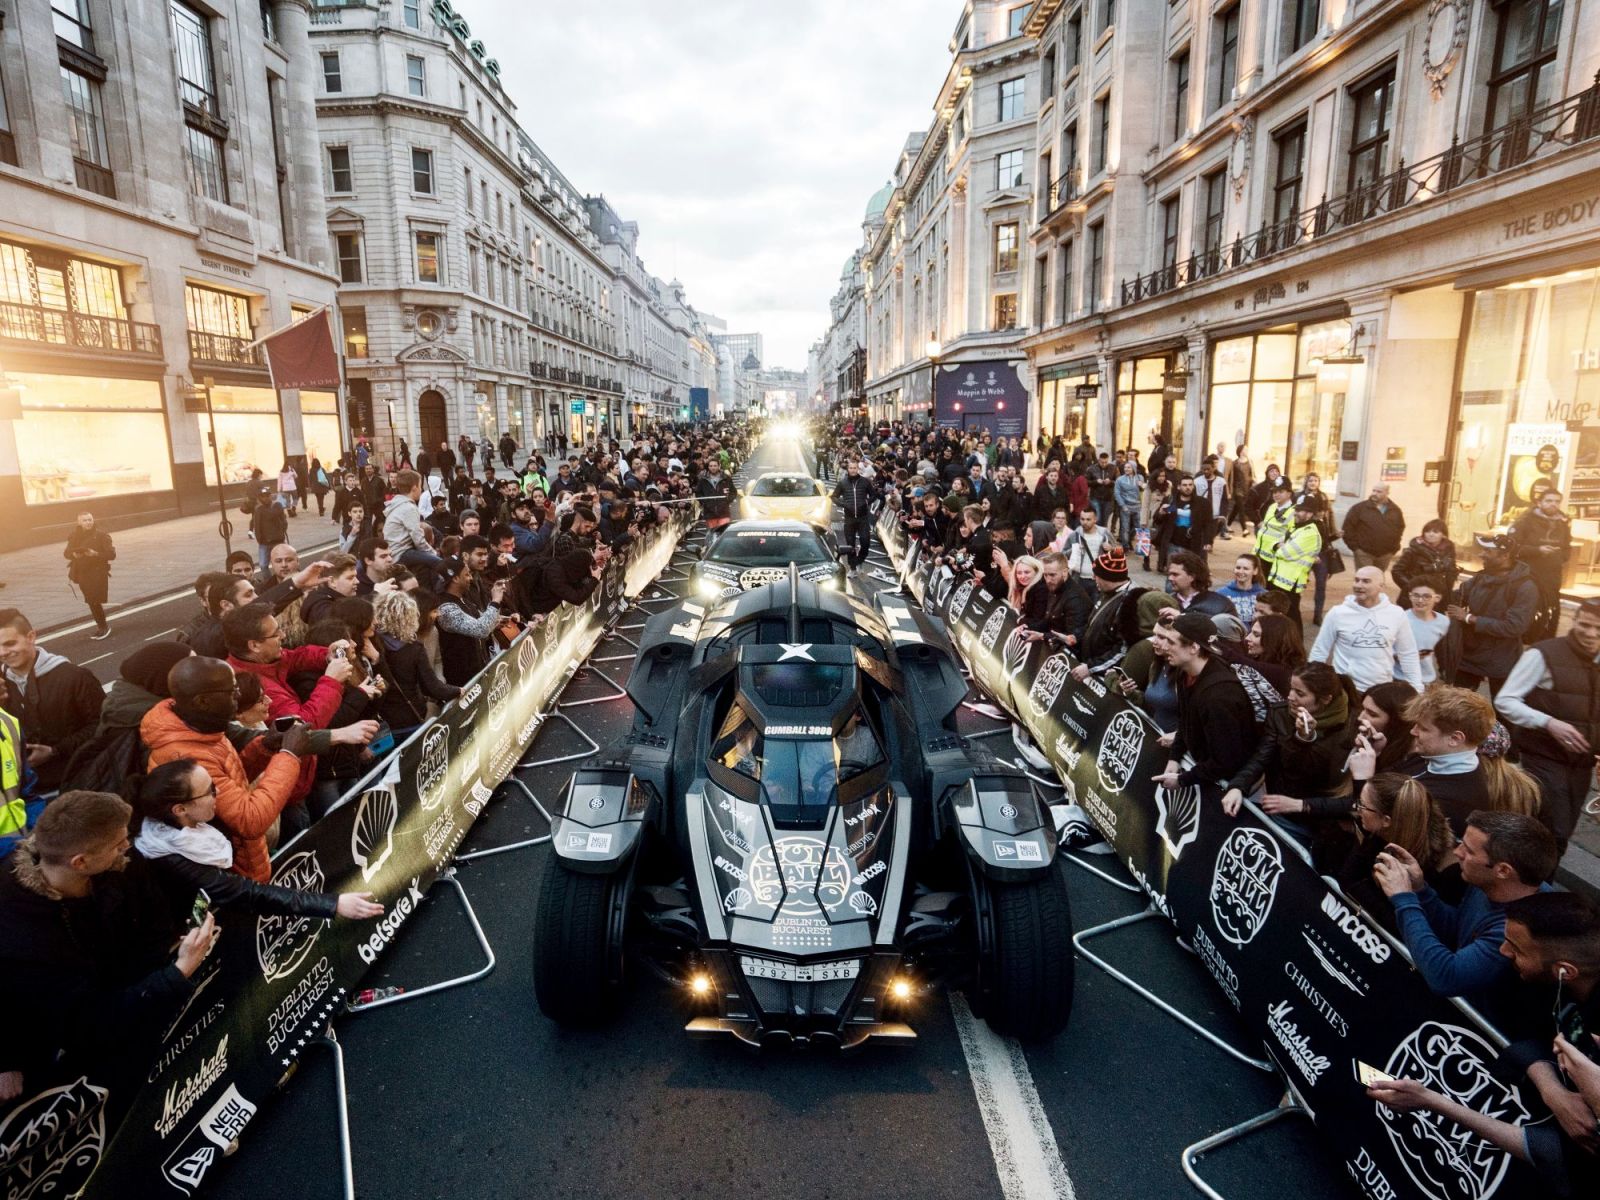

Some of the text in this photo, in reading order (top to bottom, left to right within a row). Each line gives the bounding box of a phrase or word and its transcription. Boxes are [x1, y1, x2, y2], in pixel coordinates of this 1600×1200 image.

[1503, 197, 1599, 240] THE BODY
[201, 258, 221, 271] REGENT
[223, 264, 241, 275] STREET
[1297, 280, 1309, 293] 124
[957, 388, 981, 398] Mappin
[988, 387, 1005, 396] Webb
[764, 725, 833, 735] GUMBALL 3000
[1103, 730, 1138, 769] BALL
[1113, 712, 1145, 750] GUM
[1085, 797, 1117, 841] BUCHAREST
[1087, 786, 1117, 826] DUBLIN TO
[1229, 827, 1285, 894] GUM
[1217, 848, 1270, 922] BALL
[358, 896, 412, 965] betsafe
[772, 926, 832, 935] BUCHAREST
[773, 918, 812, 926] DUBLIN
[1321, 891, 1391, 964] incase
[749, 966, 787, 980] 9292
[822, 969, 850, 980] SXB
[1196, 923, 1239, 991] DUBLIN TO
[1304, 923, 1370, 990] JETSMARTER
[266, 967, 335, 1054] BUCHAREST
[267, 972, 312, 1031] DUBLIN
[312, 956, 328, 984] TO
[1285, 961, 1349, 1038] CHRISTIE'S
[148, 998, 225, 1084] CHRISTIE'S
[1267, 1015, 1317, 1087] HEADPHONES
[1268, 1000, 1331, 1076] Marshall
[154, 1033, 229, 1132] Marshall
[161, 1058, 228, 1139] HEADPHONES
[209, 1098, 241, 1135] NEW
[222, 1108, 251, 1144] ERA
